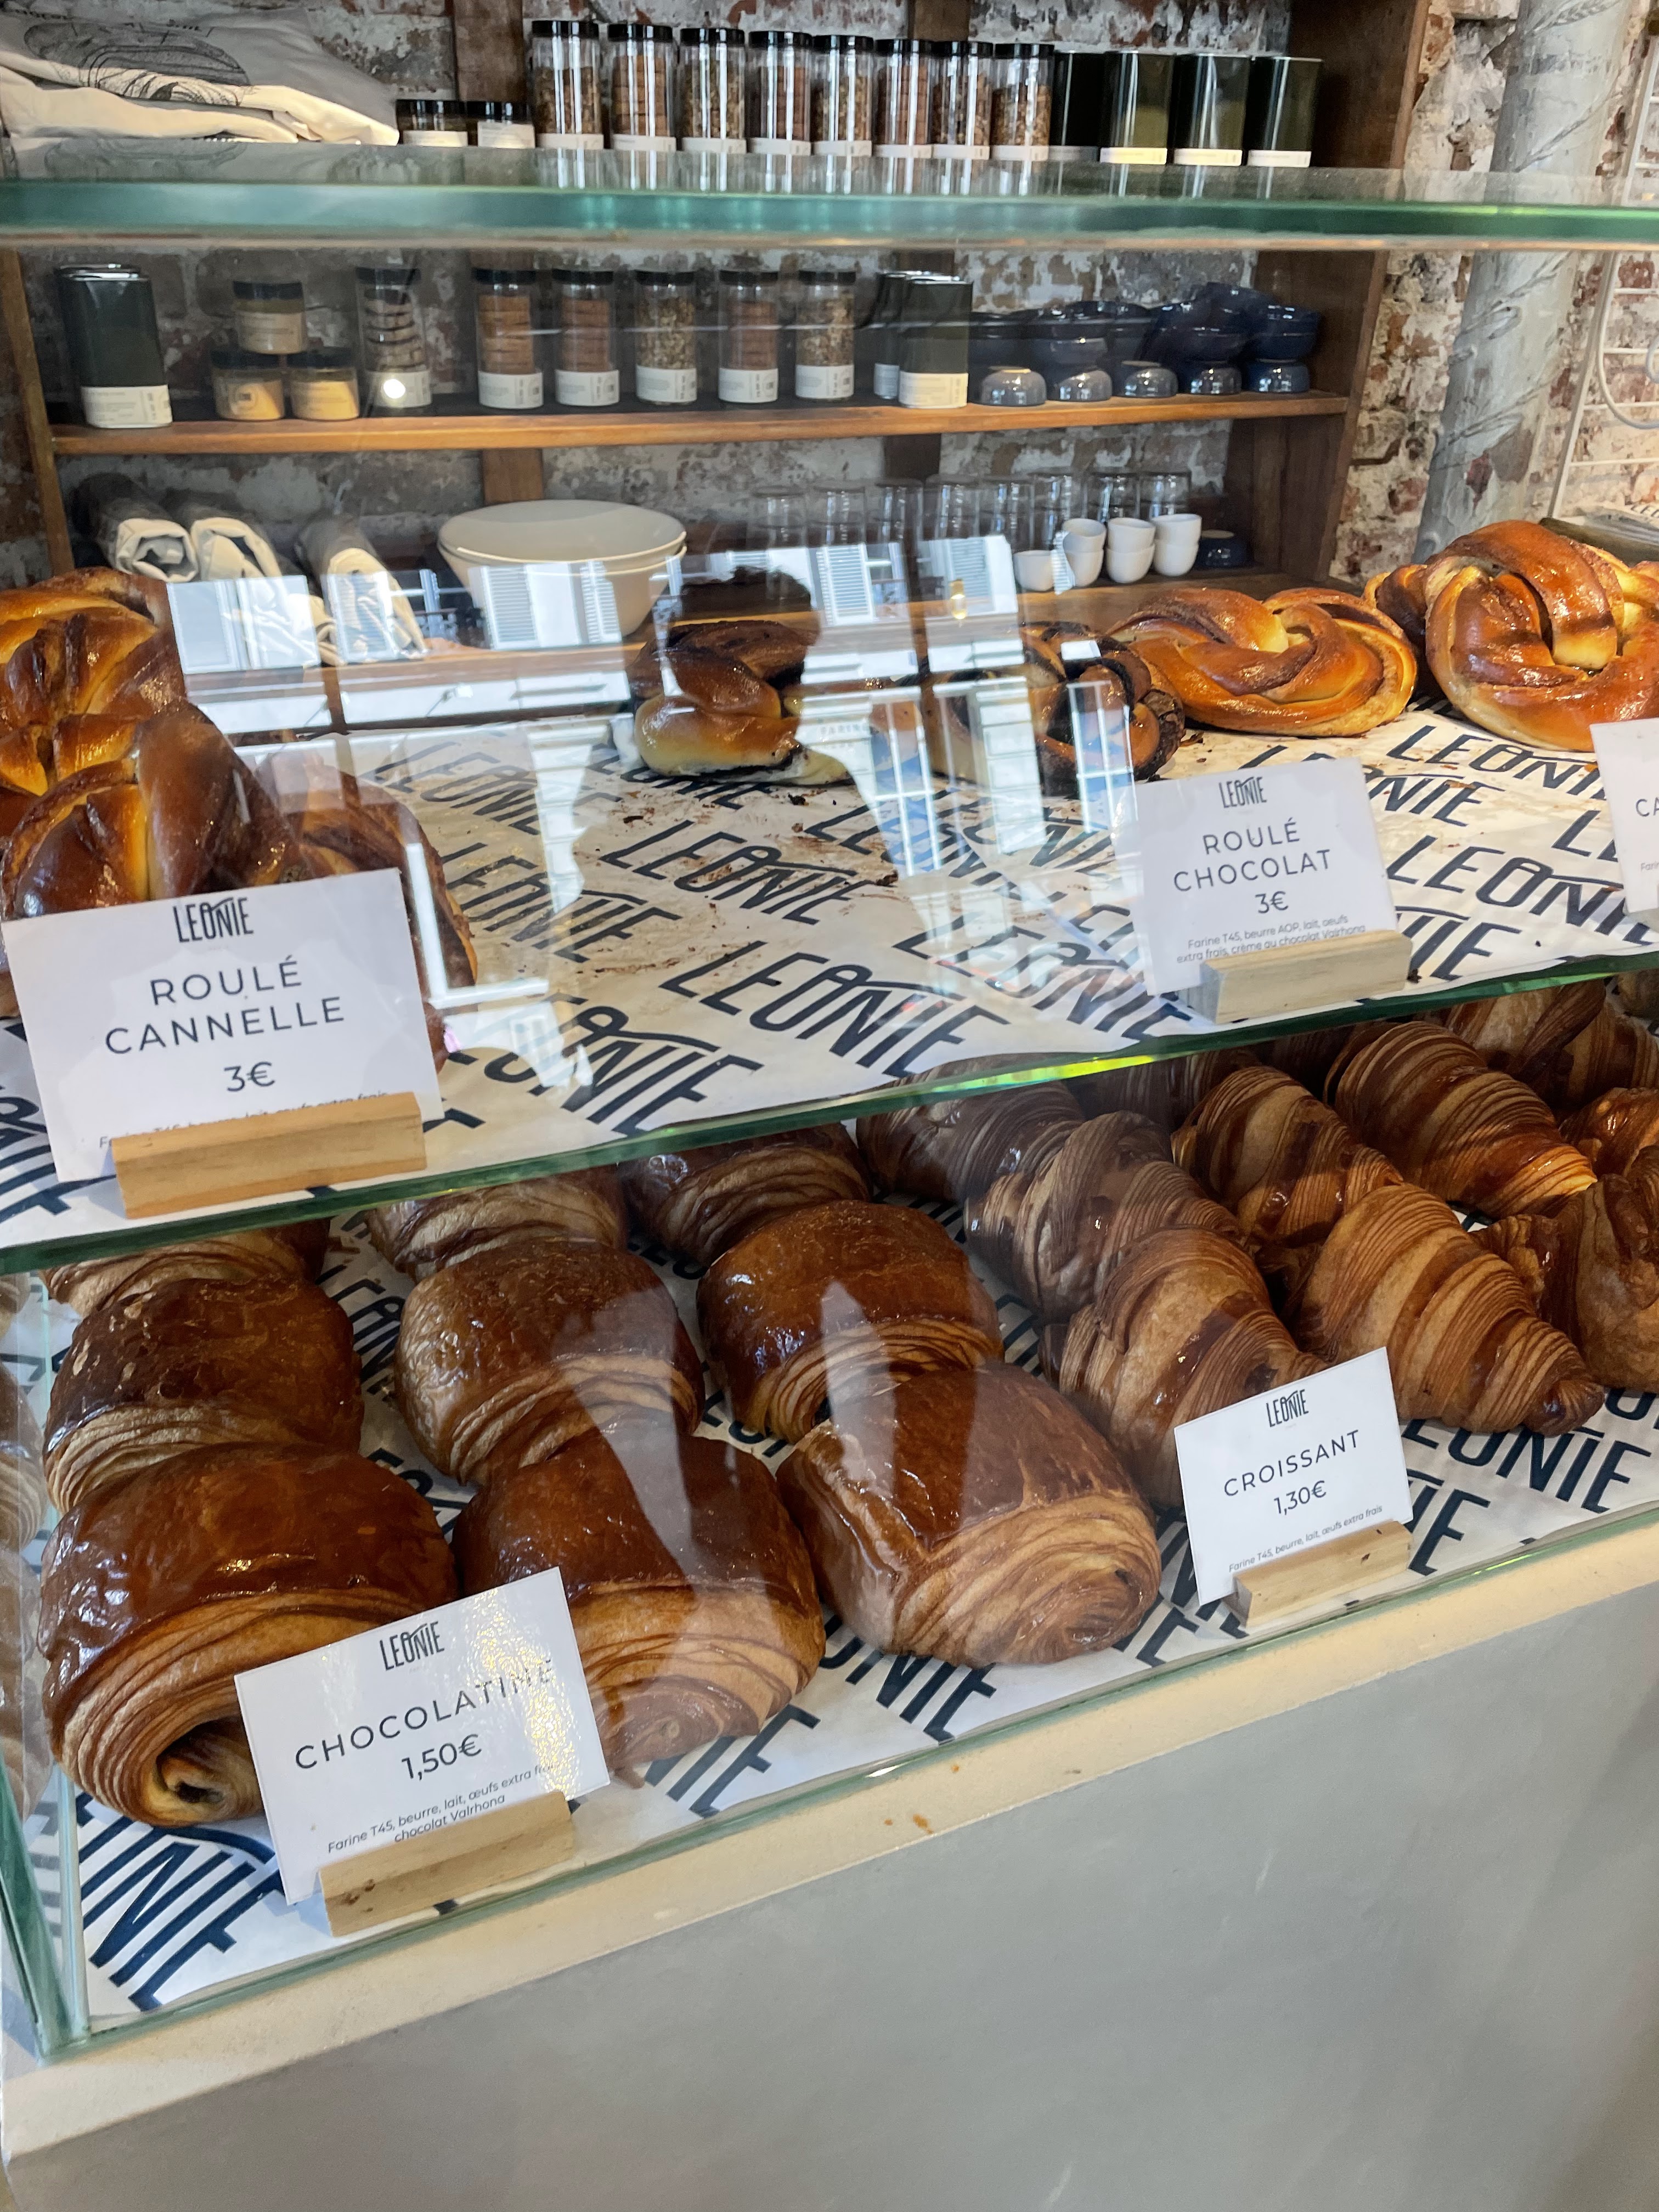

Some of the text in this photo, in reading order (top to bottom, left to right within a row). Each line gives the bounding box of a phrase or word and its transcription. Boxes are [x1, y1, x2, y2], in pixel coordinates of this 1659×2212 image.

[1386, 725, 1607, 800] LEONI
[1218, 776, 1267, 809] LEONIE
[1202, 817, 1300, 855] ROULÉ
[599, 820, 898, 925] LEONIE
[1173, 849, 1330, 892] CHOCOLAT
[172, 897, 255, 944] LEONIE
[1254, 890, 1289, 915] 3€
[1176, 951, 1203, 964] extra
[1231, 941, 1262, 956] crème
[1263, 939, 1277, 949] au
[1279, 932, 1321, 947] chocolat
[1188, 935, 1221, 950] Farine
[1222, 932, 1243, 945] T45,
[1244, 927, 1276, 940] beurre
[150, 955, 302, 1006] ROULÉ
[105, 996, 345, 1055] CANNELLE
[658, 940, 1012, 1077] LEONIE
[224, 1060, 276, 1092] 3€
[1266, 1389, 1309, 1427] LEONIE
[1224, 1429, 1359, 1497] CROISSANT
[1273, 1480, 1327, 1516] 1,30€
[1228, 1556, 1255, 1573] Farine
[1257, 1548, 1274, 1561] T45,
[1275, 1538, 1304, 1554] beurre,
[1344, 1513, 1364, 1526] extra
[1365, 1505, 1383, 1518] frais
[380, 1621, 445, 1671] LEONIE
[401, 1733, 483, 1781] 1,50€
[328, 1831, 368, 1853] Farine
[369, 1821, 396, 1838] T45,
[398, 1805, 442, 1827] beurre,
[444, 1793, 467, 1810] lait,
[501, 1768, 532, 1789] extra
[394, 1794, 506, 1843] chocolat Valrhona
